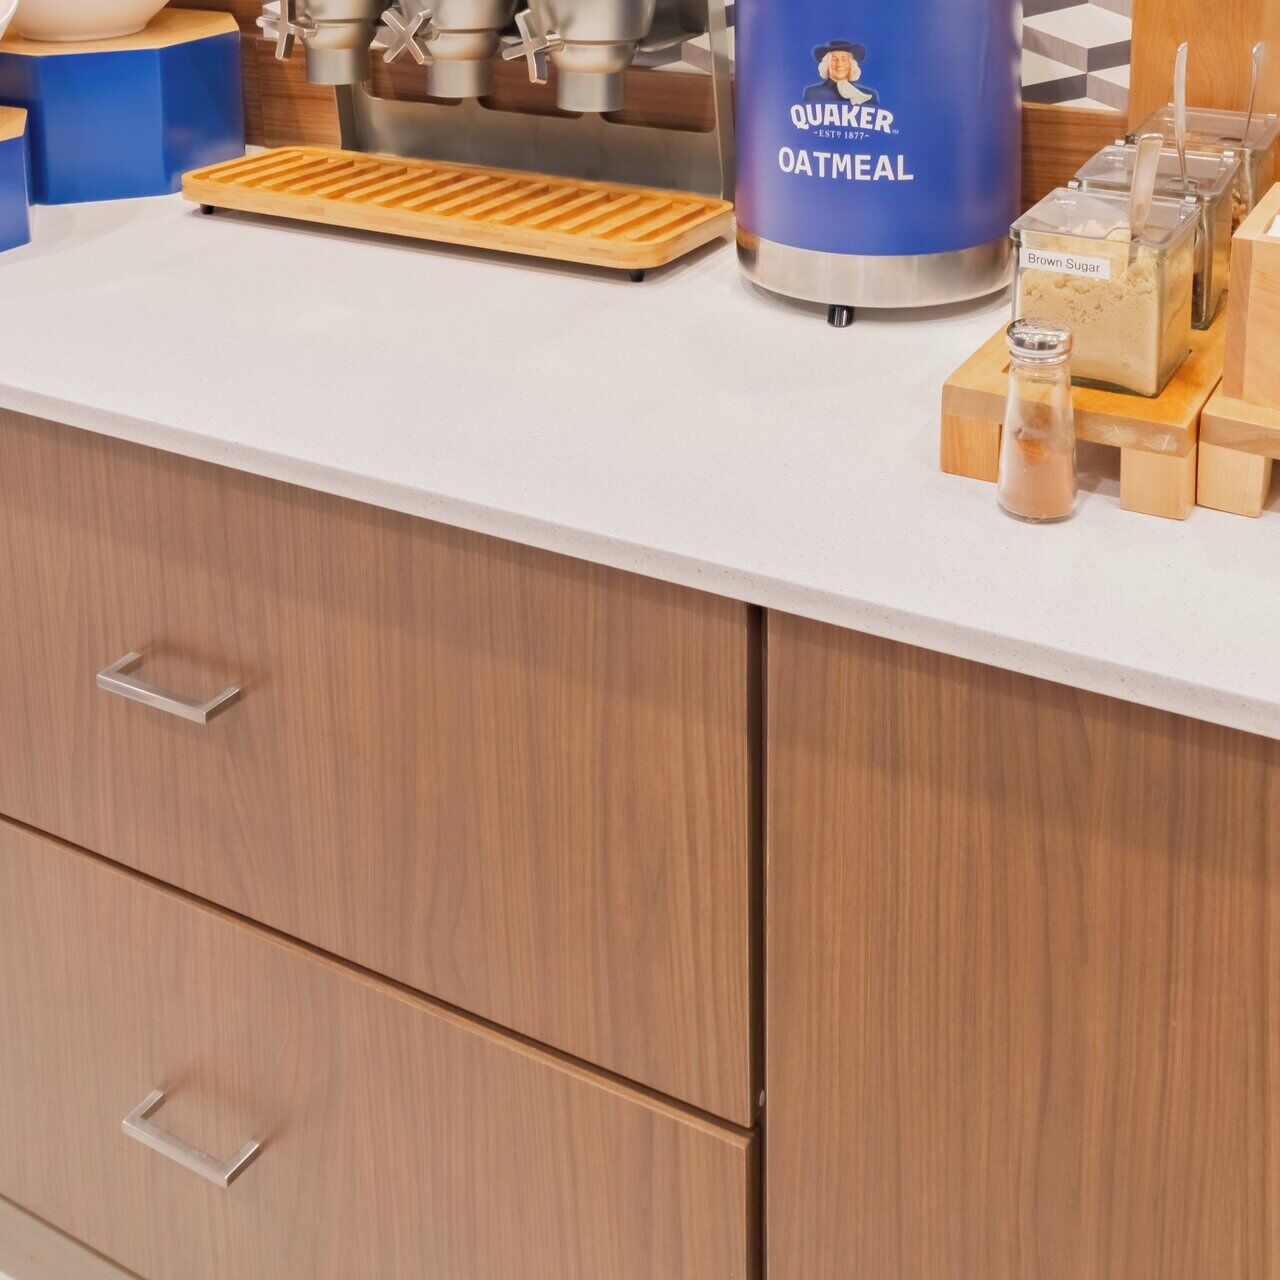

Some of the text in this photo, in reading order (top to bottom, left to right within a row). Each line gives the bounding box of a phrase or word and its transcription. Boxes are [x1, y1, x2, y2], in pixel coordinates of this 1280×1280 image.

[790, 103, 894, 134] QUAKER
[844, 131, 865, 140] 1877
[778, 146, 914, 181] OATMEAL
[1028, 253, 1101, 273] Brown Sugar
